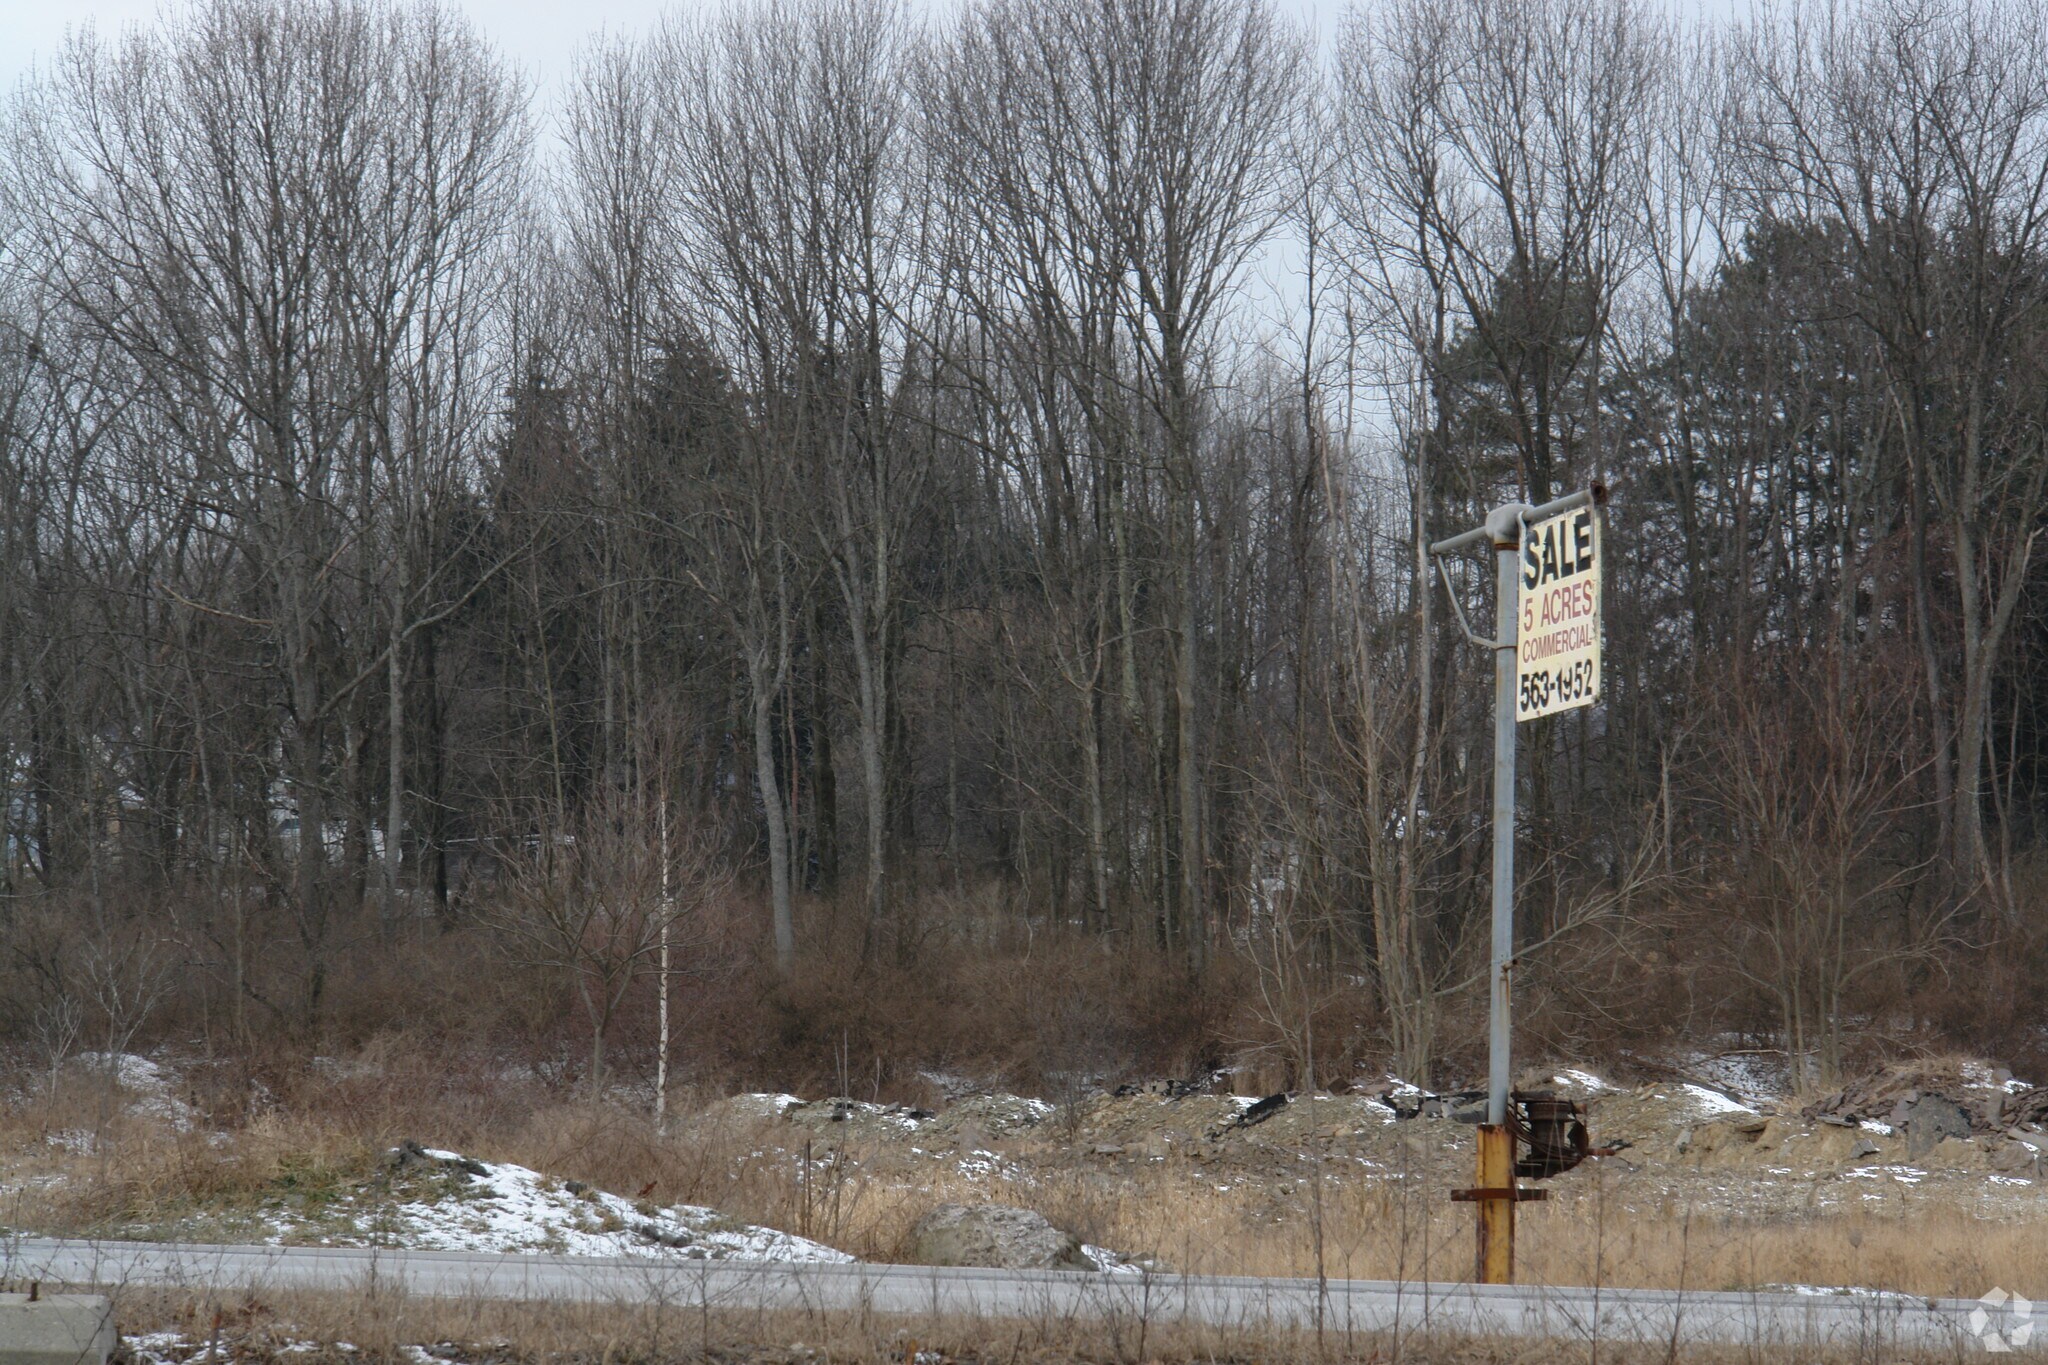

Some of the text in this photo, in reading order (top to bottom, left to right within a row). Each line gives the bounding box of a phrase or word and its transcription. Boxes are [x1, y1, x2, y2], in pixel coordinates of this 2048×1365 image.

[1524, 510, 1592, 590] SALE
[1523, 579, 1592, 632] 5 ACRES
[1522, 623, 1592, 664] COMMERCIAL
[1520, 659, 1593, 712] 563-1952
